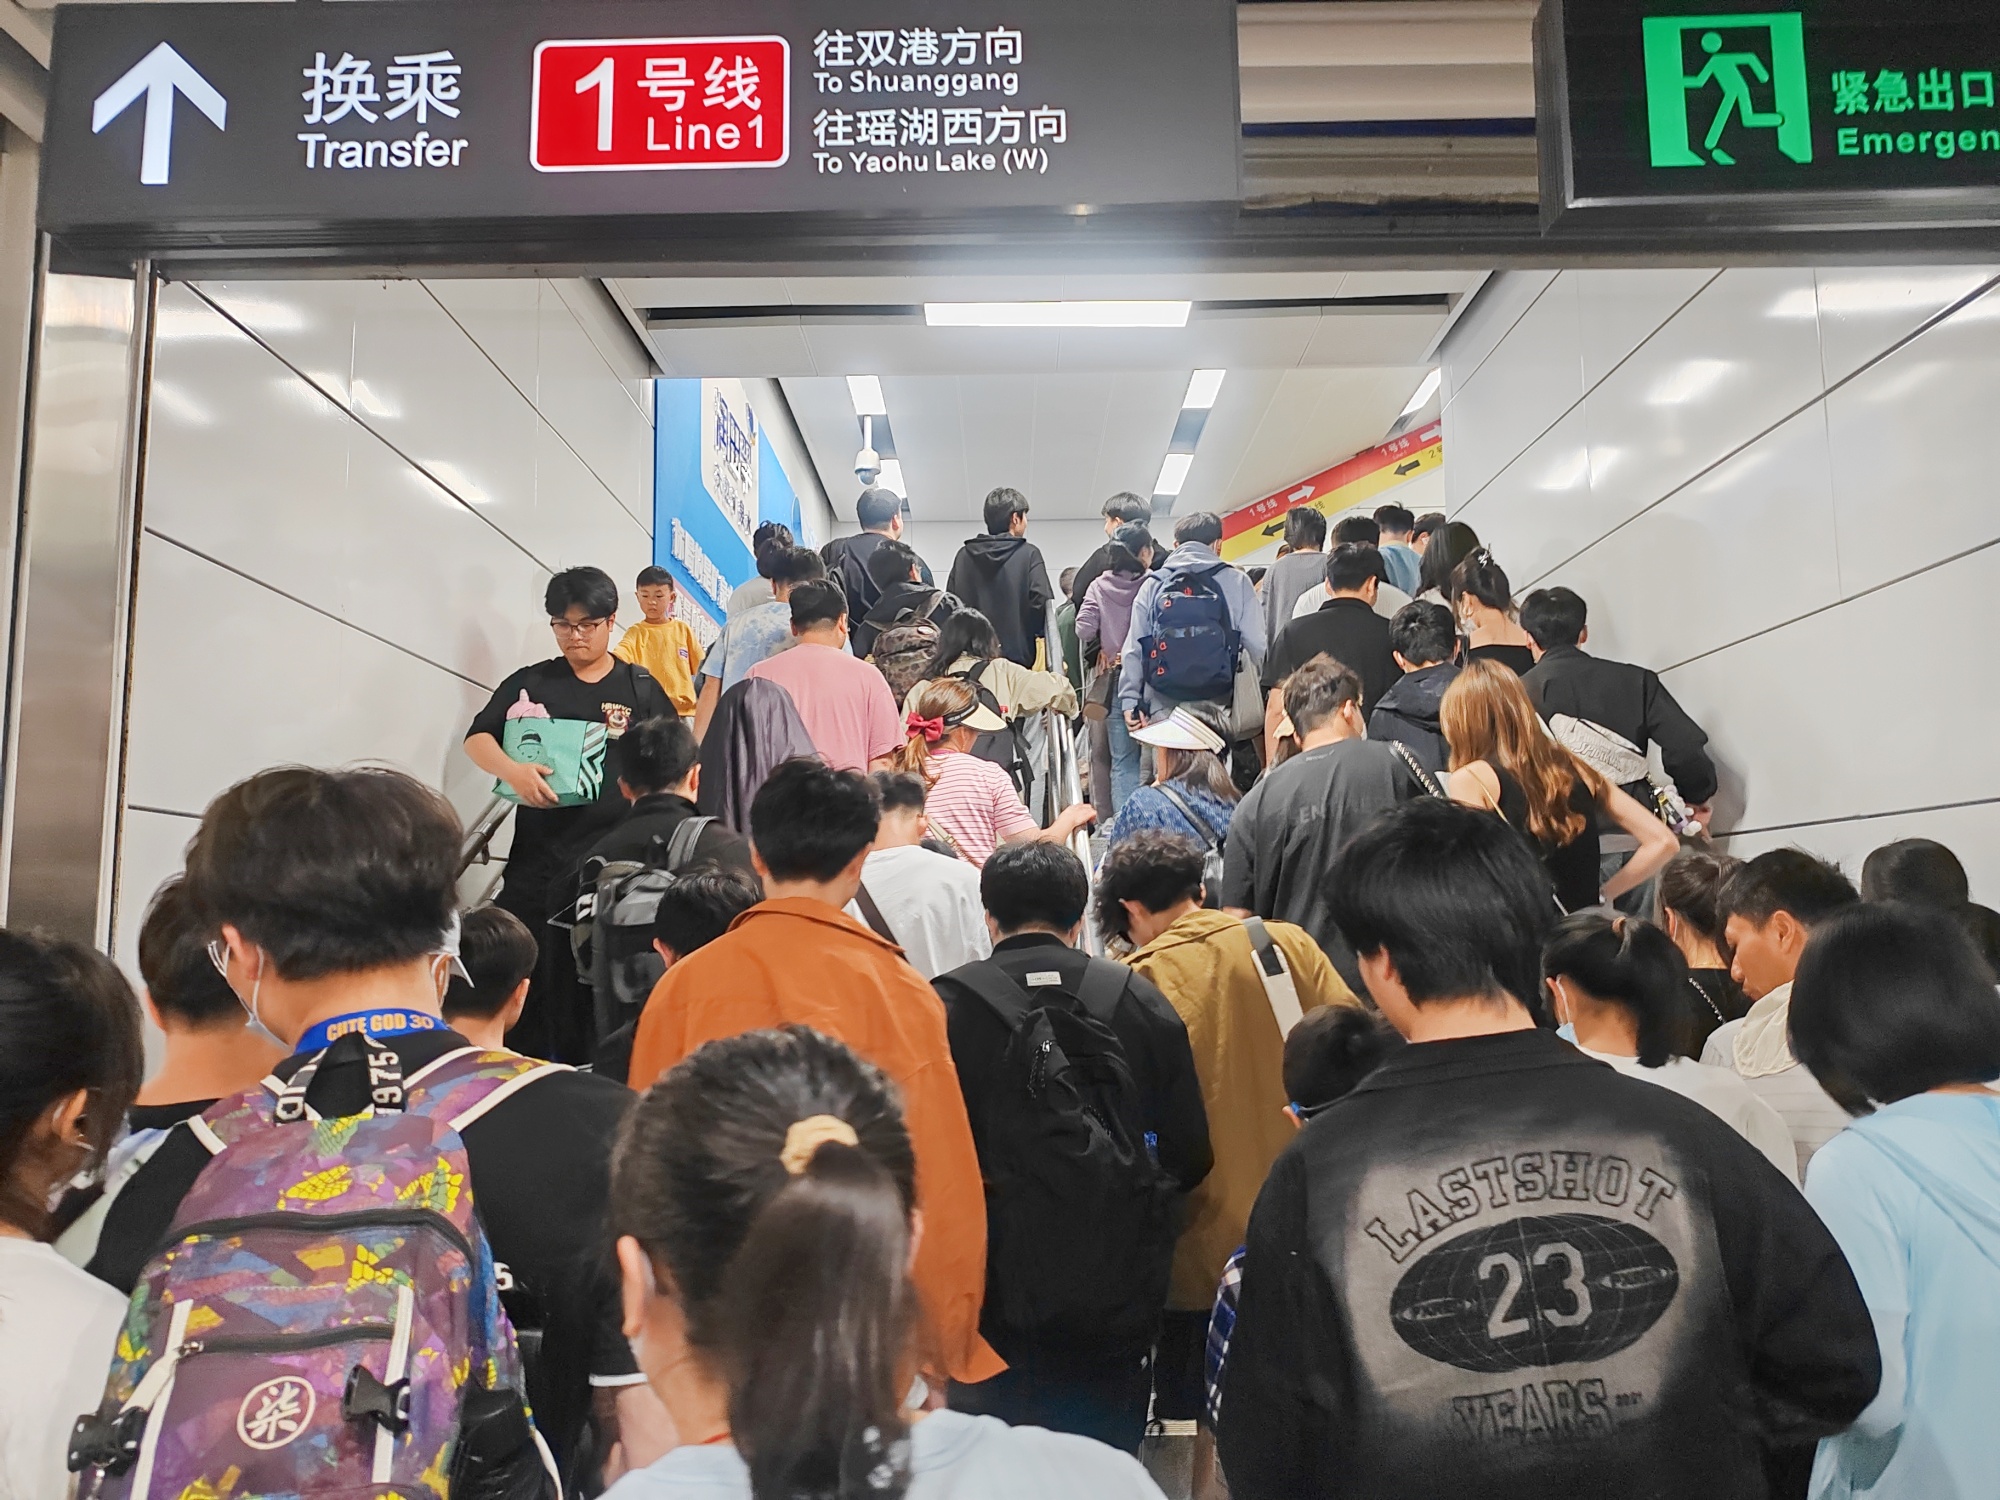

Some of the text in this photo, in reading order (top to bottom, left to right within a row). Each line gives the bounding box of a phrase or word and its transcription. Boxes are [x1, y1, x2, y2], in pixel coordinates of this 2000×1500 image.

[813, 25, 1023, 68] 往双港方向
[301, 49, 462, 125] 换乘
[813, 70, 1019, 97] To Shuanggang
[1831, 66, 1994, 116] 紧急出口
[813, 104, 1067, 148] 往瑶湖西方向
[1837, 127, 2000, 160] Emergen
[297, 130, 469, 169] Transfer
[813, 147, 1048, 175] To Yaohu Lake (W)
[1248, 498, 1278, 517] 1号线
[1364, 1150, 1677, 1264] LASTSHOT
[1478, 1241, 1593, 1339] 23
[245, 1381, 301, 1442] 柒
